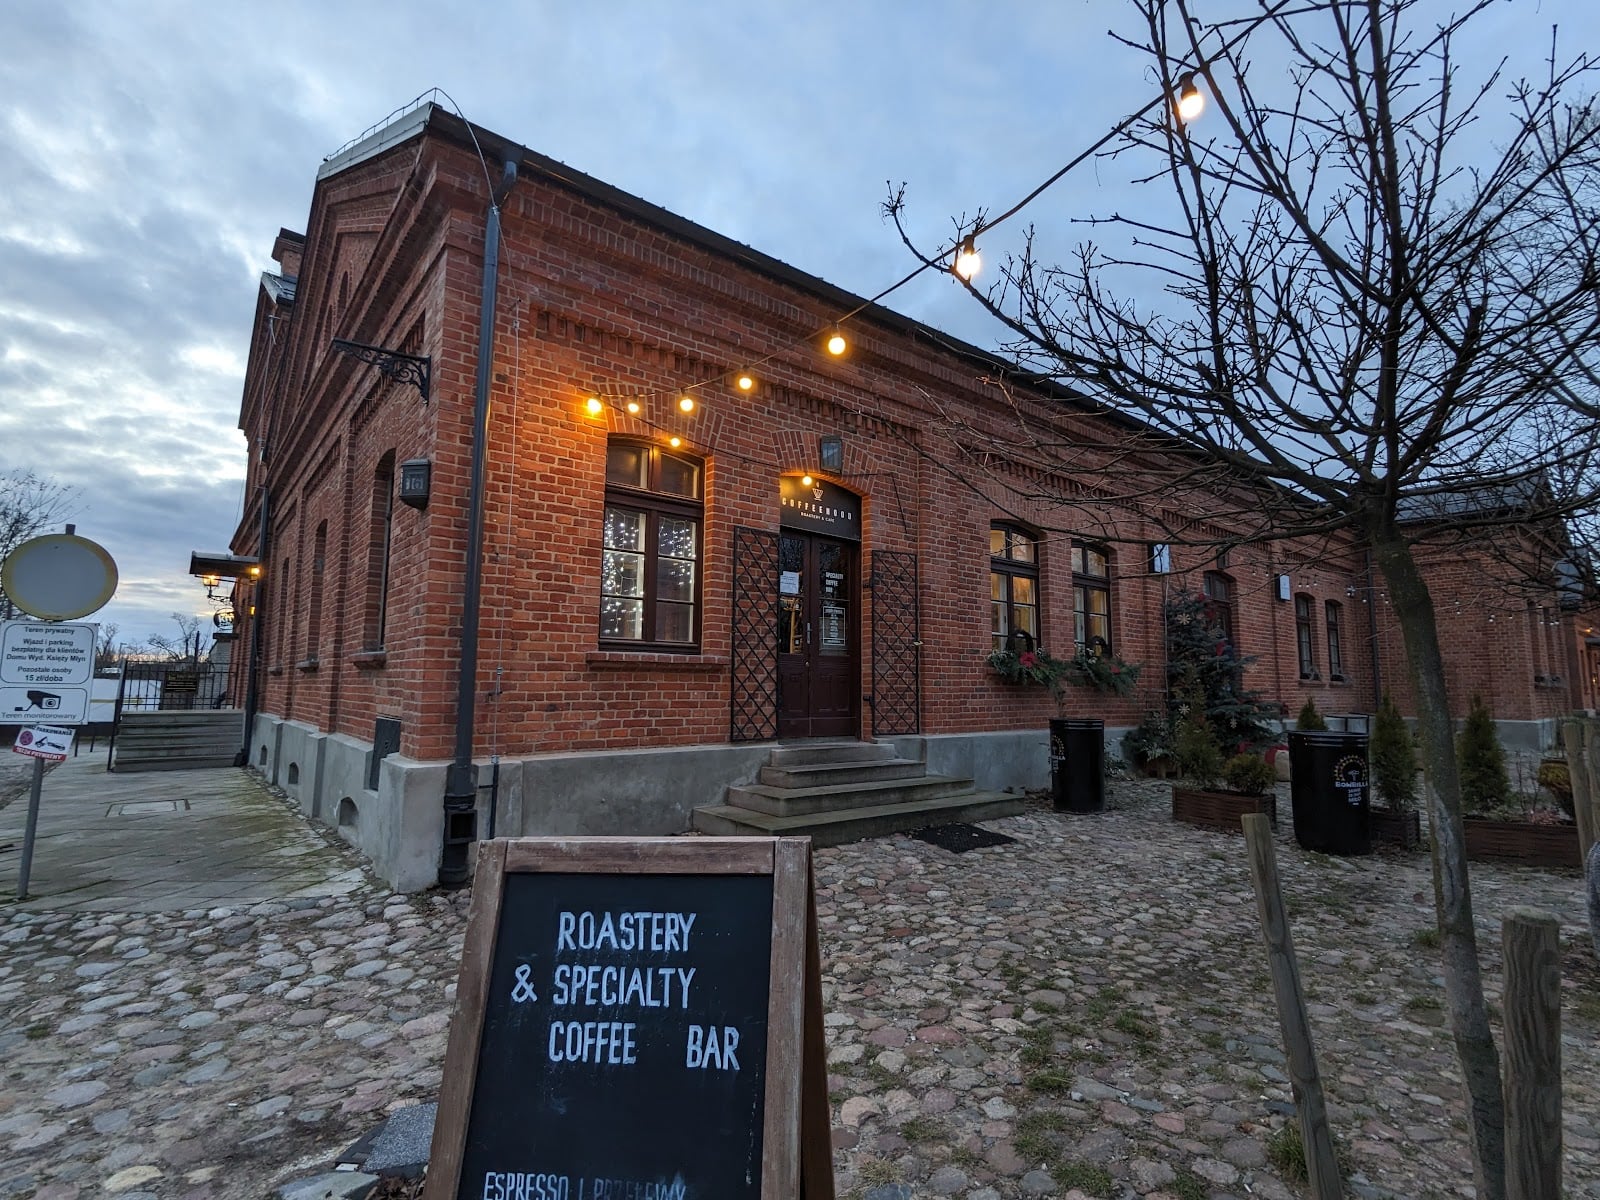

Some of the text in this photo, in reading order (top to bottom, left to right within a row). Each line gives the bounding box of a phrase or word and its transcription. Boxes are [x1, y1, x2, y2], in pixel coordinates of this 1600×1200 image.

[23, 638, 44, 646] Wjazd
[45, 627, 75, 635] prywatny
[1, 711, 77, 720] Teren monitorowany
[558, 911, 697, 952] ROASTERY
[511, 963, 697, 1009] & SPECIALTY
[548, 1021, 740, 1071] COFFEE BAR
[484, 1172, 569, 1200] ESPRESSO
